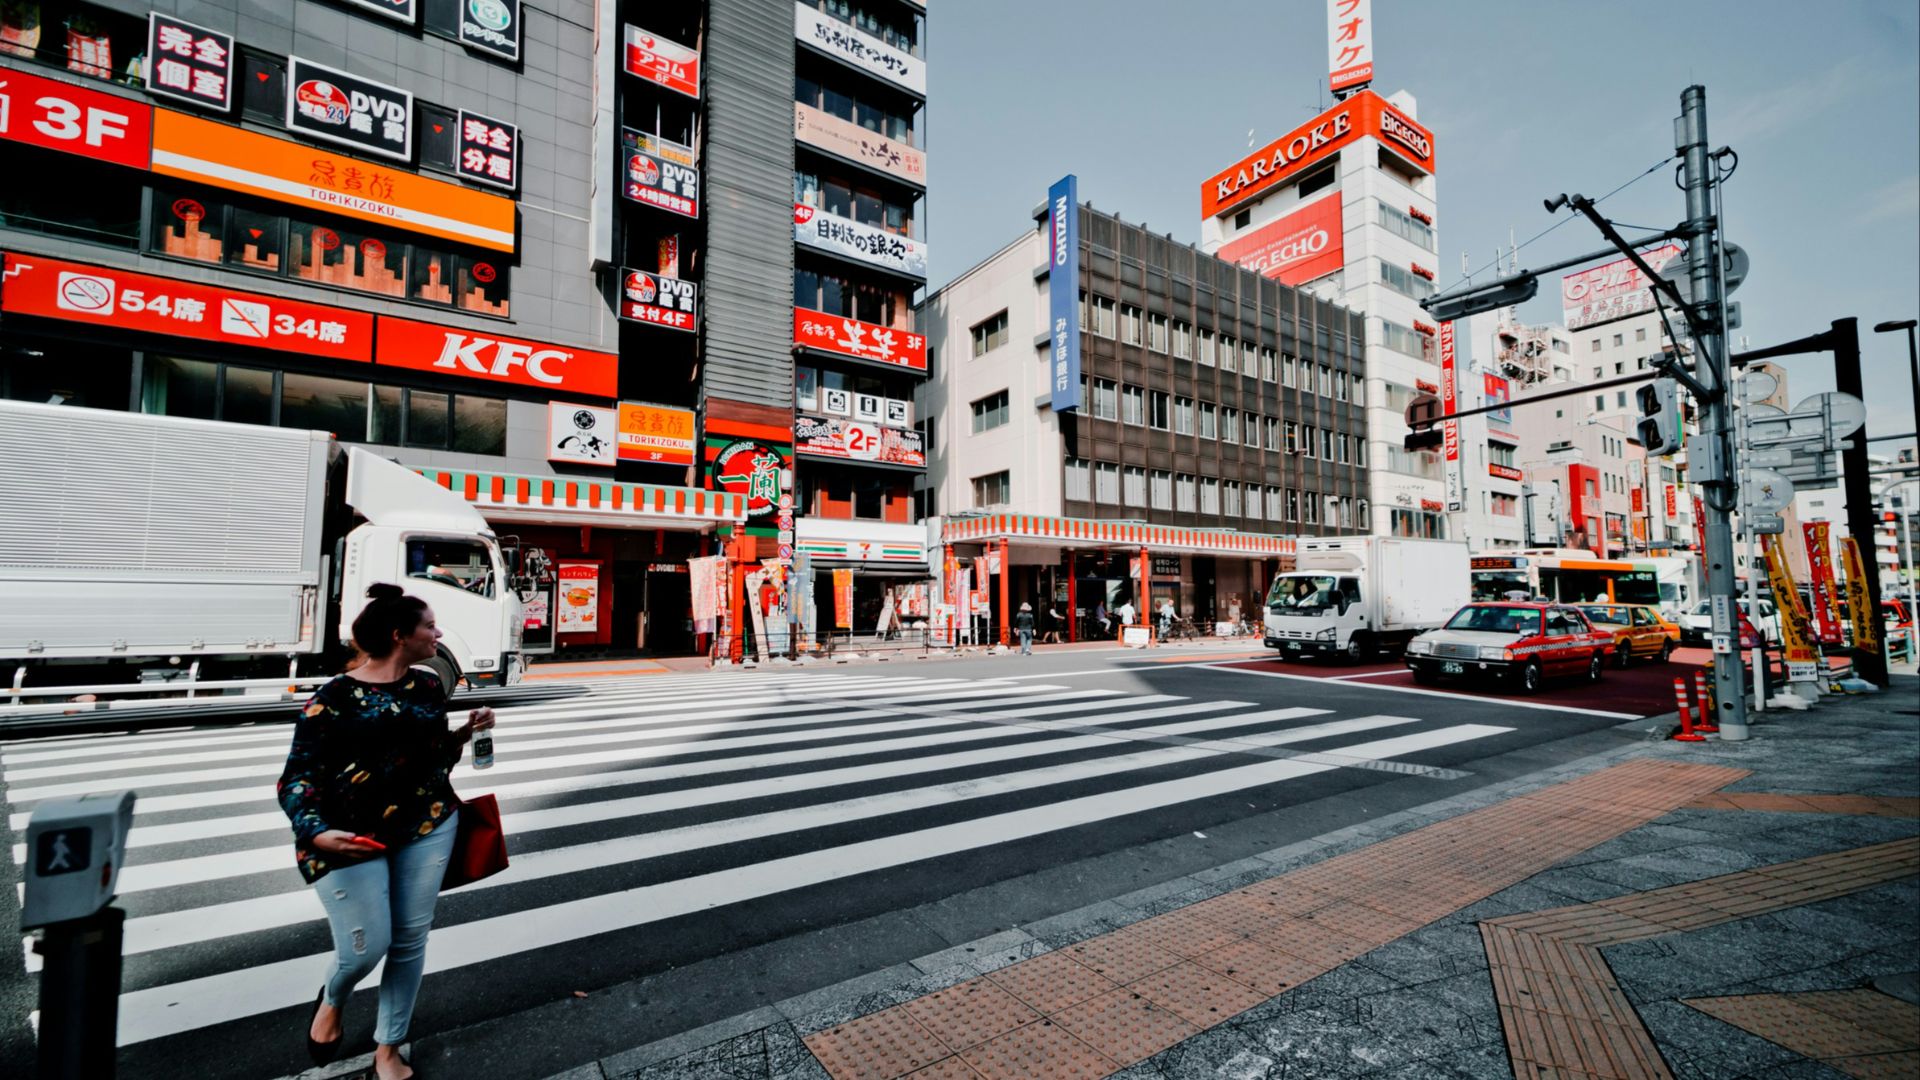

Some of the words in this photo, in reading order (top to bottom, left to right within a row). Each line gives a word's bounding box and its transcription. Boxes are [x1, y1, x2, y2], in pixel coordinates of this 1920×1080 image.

[159, 25, 227, 68] 完全
[157, 58, 224, 100] 個室
[639, 50, 686, 79] アコム
[32, 96, 129, 147] 3F
[350, 91, 406, 122] DVD
[464, 119, 511, 152] 完全
[463, 149, 511, 181] 分煙
[1216, 110, 1351, 202] KARAOKE
[309, 160, 395, 200] 鳥貴族
[662, 162, 696, 184] DVD
[310, 187, 396, 217] TORIKIZOKU
[795, 207, 813, 219] 4F
[817, 219, 906, 260] 目利きの銀次
[1056, 195, 1067, 266] MIZUHO
[659, 278, 694, 298] DVD
[120, 289, 206, 322] 54席
[274, 314, 347, 345] 34席
[907, 335, 922, 350] 3F
[433, 332, 570, 384] KFC
[1056, 318, 1068, 392] みずほ銀行
[629, 411, 684, 435] 鳥貴族
[629, 434, 685, 448] TORIKIZOKU
[849, 428, 877, 452] 2F
[717, 453, 782, 506] 一蘭
